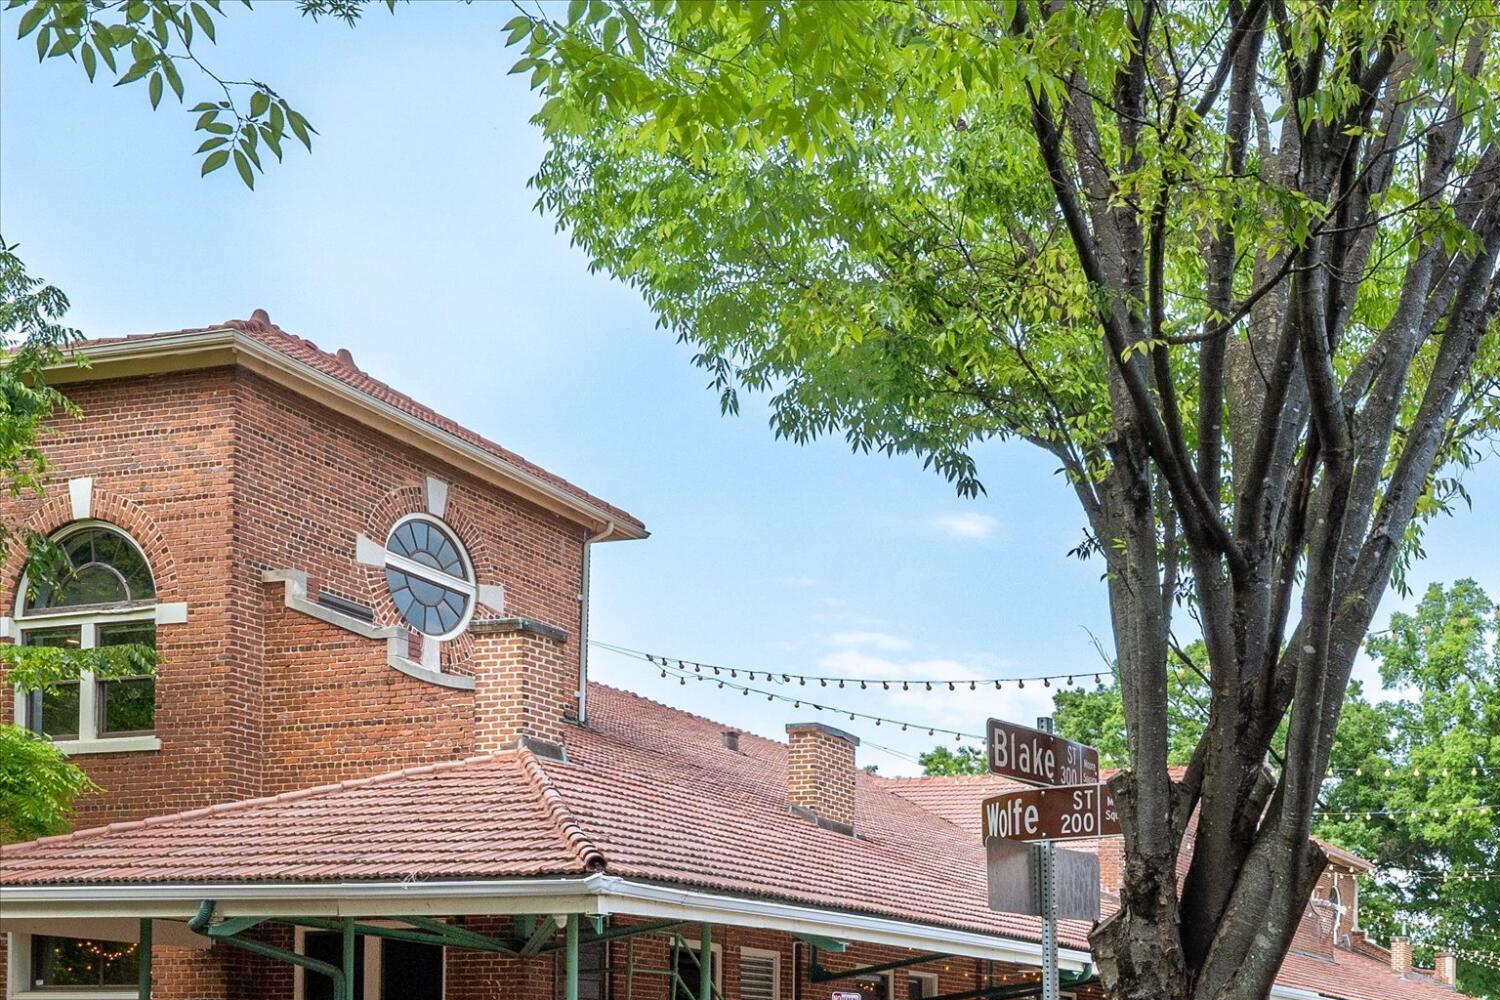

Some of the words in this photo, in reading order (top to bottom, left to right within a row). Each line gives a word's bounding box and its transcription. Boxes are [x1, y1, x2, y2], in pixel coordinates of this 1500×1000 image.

[993, 728, 1055, 779] Blake
[1067, 745, 1077, 766] ST
[1060, 766, 1077, 786] 300
[986, 799, 1039, 838] Wolfe
[1073, 790, 1094, 810] ST
[1060, 813, 1094, 834] 200
